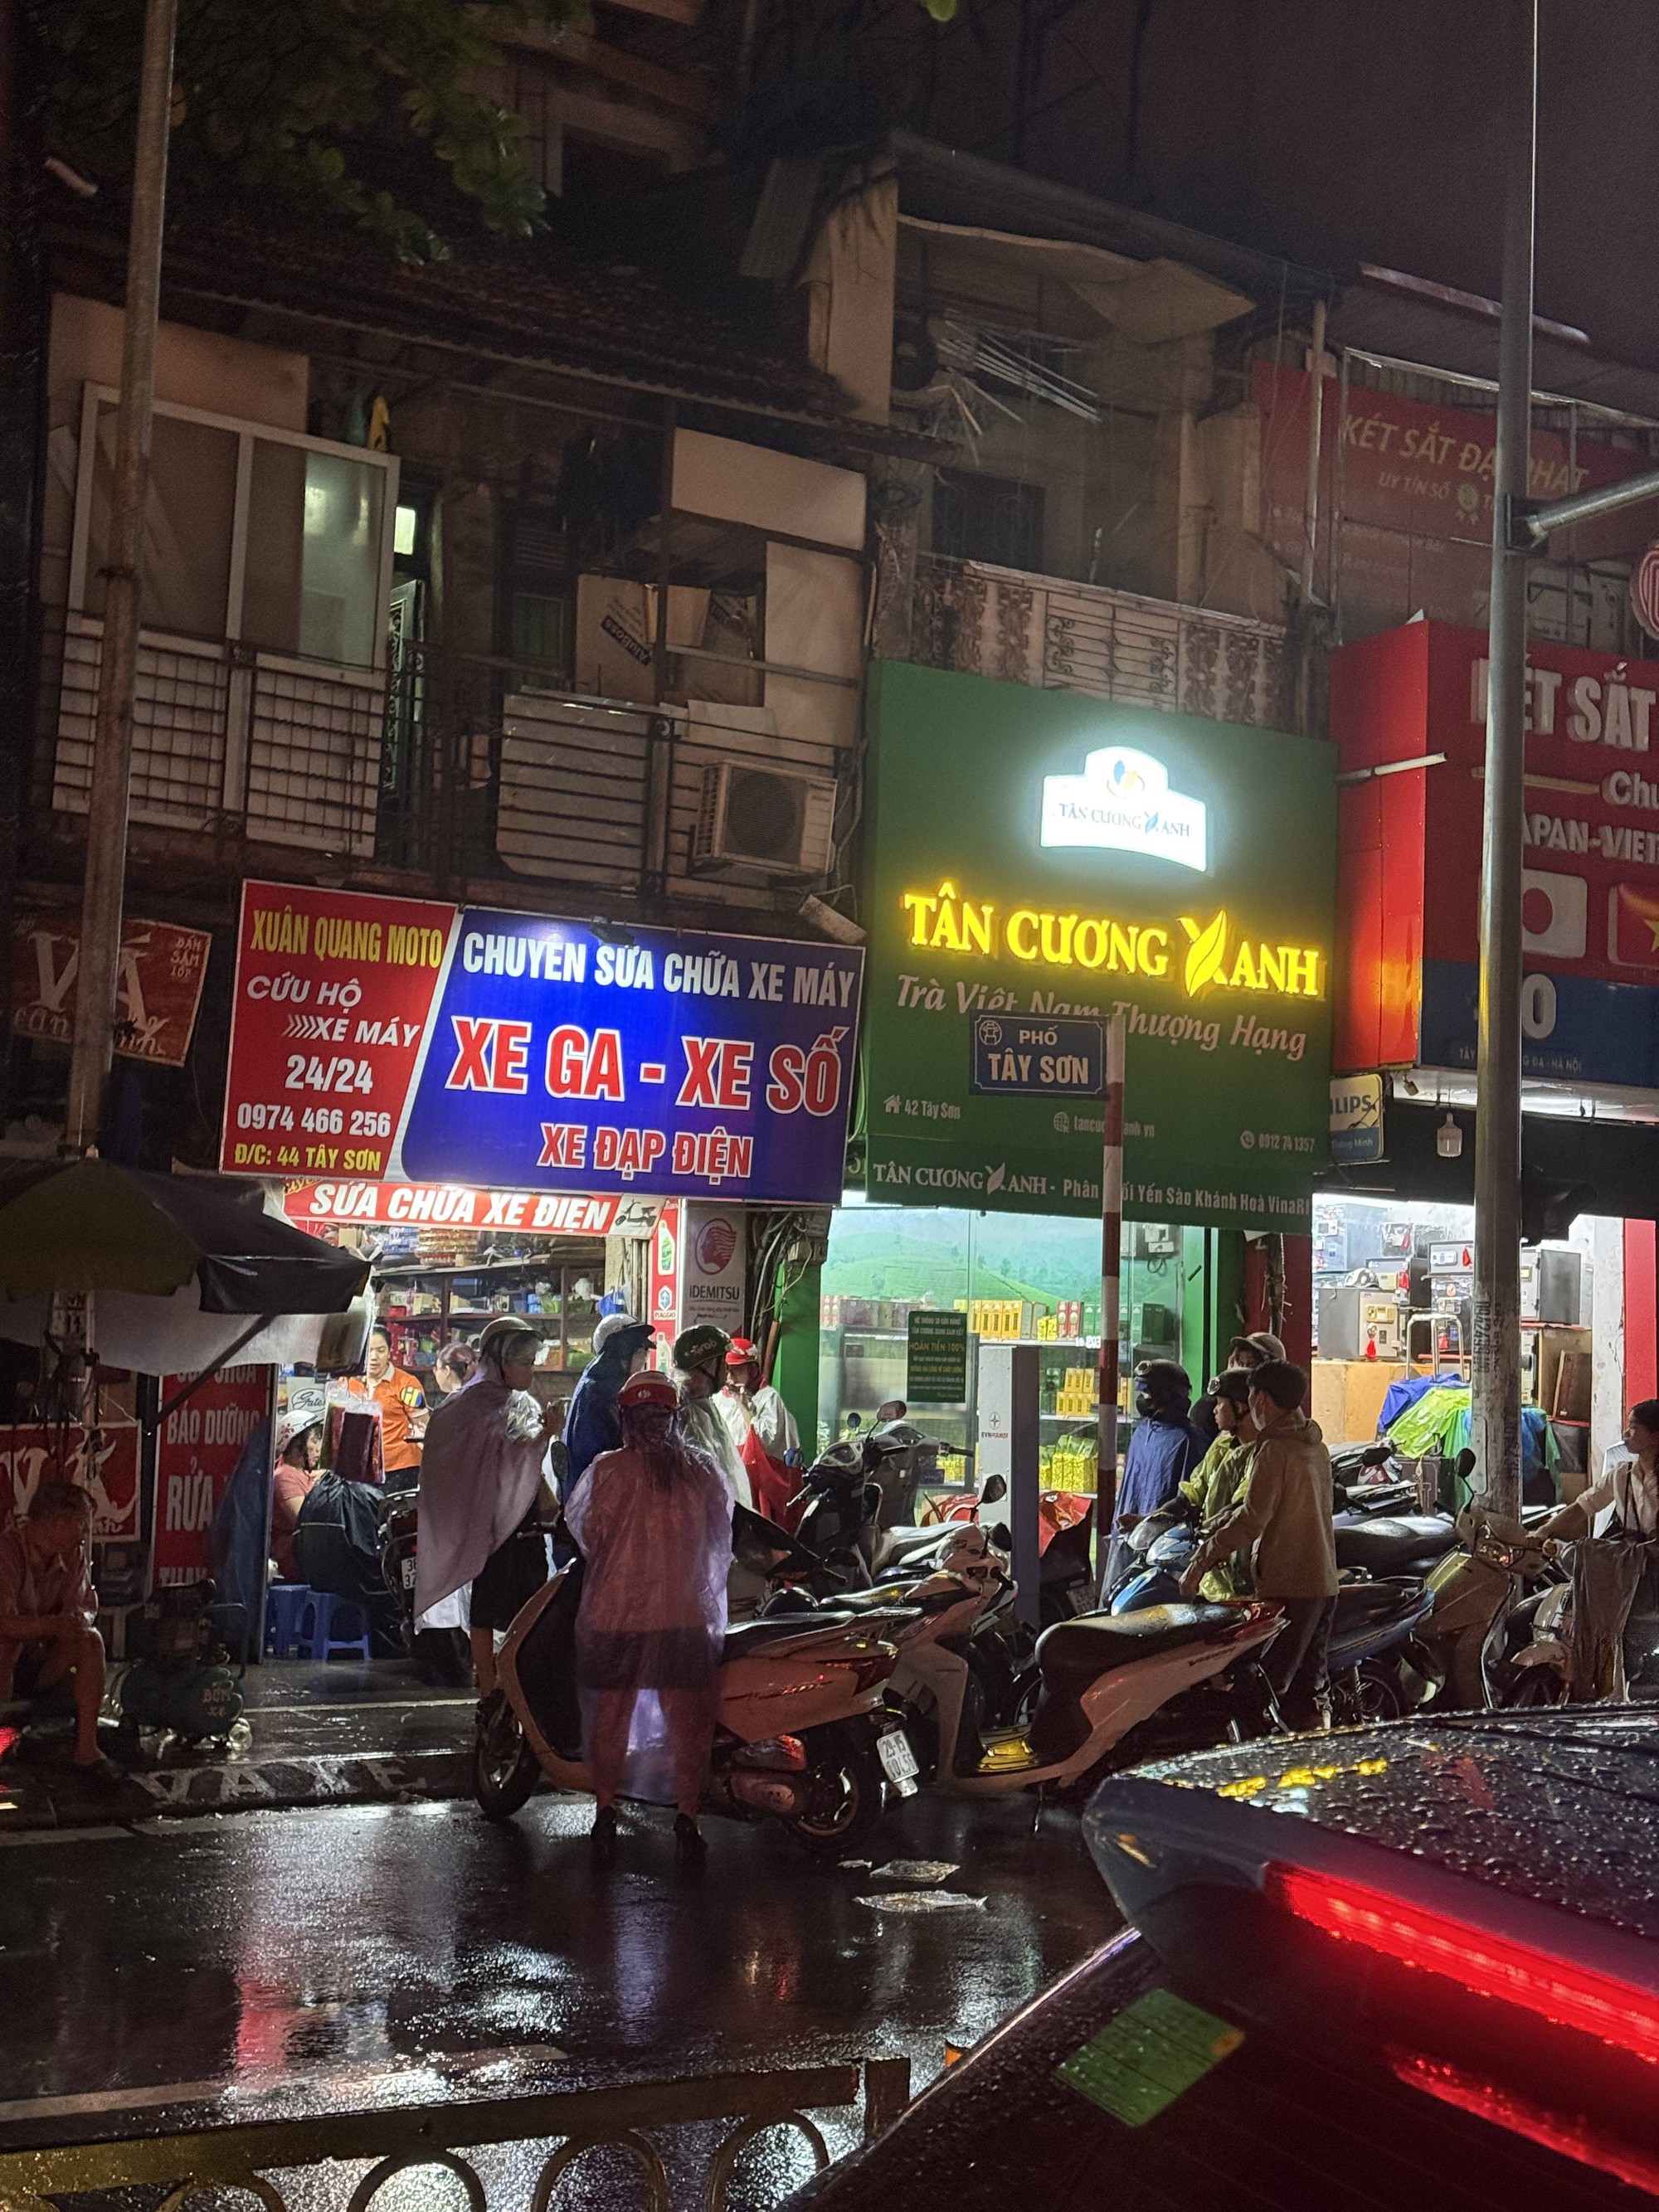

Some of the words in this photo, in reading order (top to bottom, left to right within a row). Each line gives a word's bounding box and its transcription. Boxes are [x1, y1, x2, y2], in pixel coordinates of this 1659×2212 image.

[1457, 442, 1497, 482] ĐẠ
[251, 905, 308, 955] XUÂN
[314, 916, 381, 964] QUANG
[386, 924, 443, 969] MOTO
[903, 881, 994, 955] TÂN
[1006, 910, 1169, 977] CƯƠNG
[247, 971, 309, 1004] CỨU
[317, 977, 362, 1014] HỘ
[664, 950, 740, 998] CHỮA
[748, 961, 786, 1002] XE
[792, 962, 855, 1008] MÁY
[314, 1020, 347, 1042] XE
[355, 1016, 420, 1048] MÁY
[898, 974, 946, 1011] Trà
[1112, 1000, 1221, 1052] Thượng
[1229, 1014, 1306, 1062] Hạng
[1019, 1025, 1058, 1046] PHỐ
[285, 1055, 373, 1095] 24/24
[445, 1015, 533, 1095] XE
[545, 1024, 625, 1102] GA
[640, 1062, 666, 1085] -
[676, 1034, 755, 1111] XE
[766, 1027, 850, 1117] SỐ
[988, 1048, 1032, 1082] TÂY
[1039, 1054, 1089, 1085] SƠN
[237, 1103, 294, 1132] 0974
[300, 1107, 343, 1135] 466
[348, 1110, 391, 1138] 256
[904, 1099, 918, 1116] 42
[921, 1100, 939, 1119] Tây
[941, 1102, 961, 1120] Sơn
[235, 1143, 272, 1165] Đ/C:
[276, 1146, 299, 1168] 44
[305, 1143, 338, 1170] TÂY
[343, 1148, 381, 1171] SƠN
[537, 1123, 588, 1169] XE
[595, 1126, 664, 1181] ĐẠP
[673, 1125, 754, 1186] ĐIỆN
[873, 1160, 912, 1184] TÂN
[915, 1167, 983, 1189] CƯƠNG
[1063, 1179, 1099, 1199] Phân
[1137, 1183, 1162, 1203] Yến
[1166, 1187, 1191, 1207] Sào
[1194, 1189, 1236, 1211] Khánh
[1240, 1193, 1264, 1213] Hoà
[481, 1192, 532, 1227] XE
[654, 1311, 676, 1320] PIAGGIO
[166, 1456, 214, 1532] RỬA
